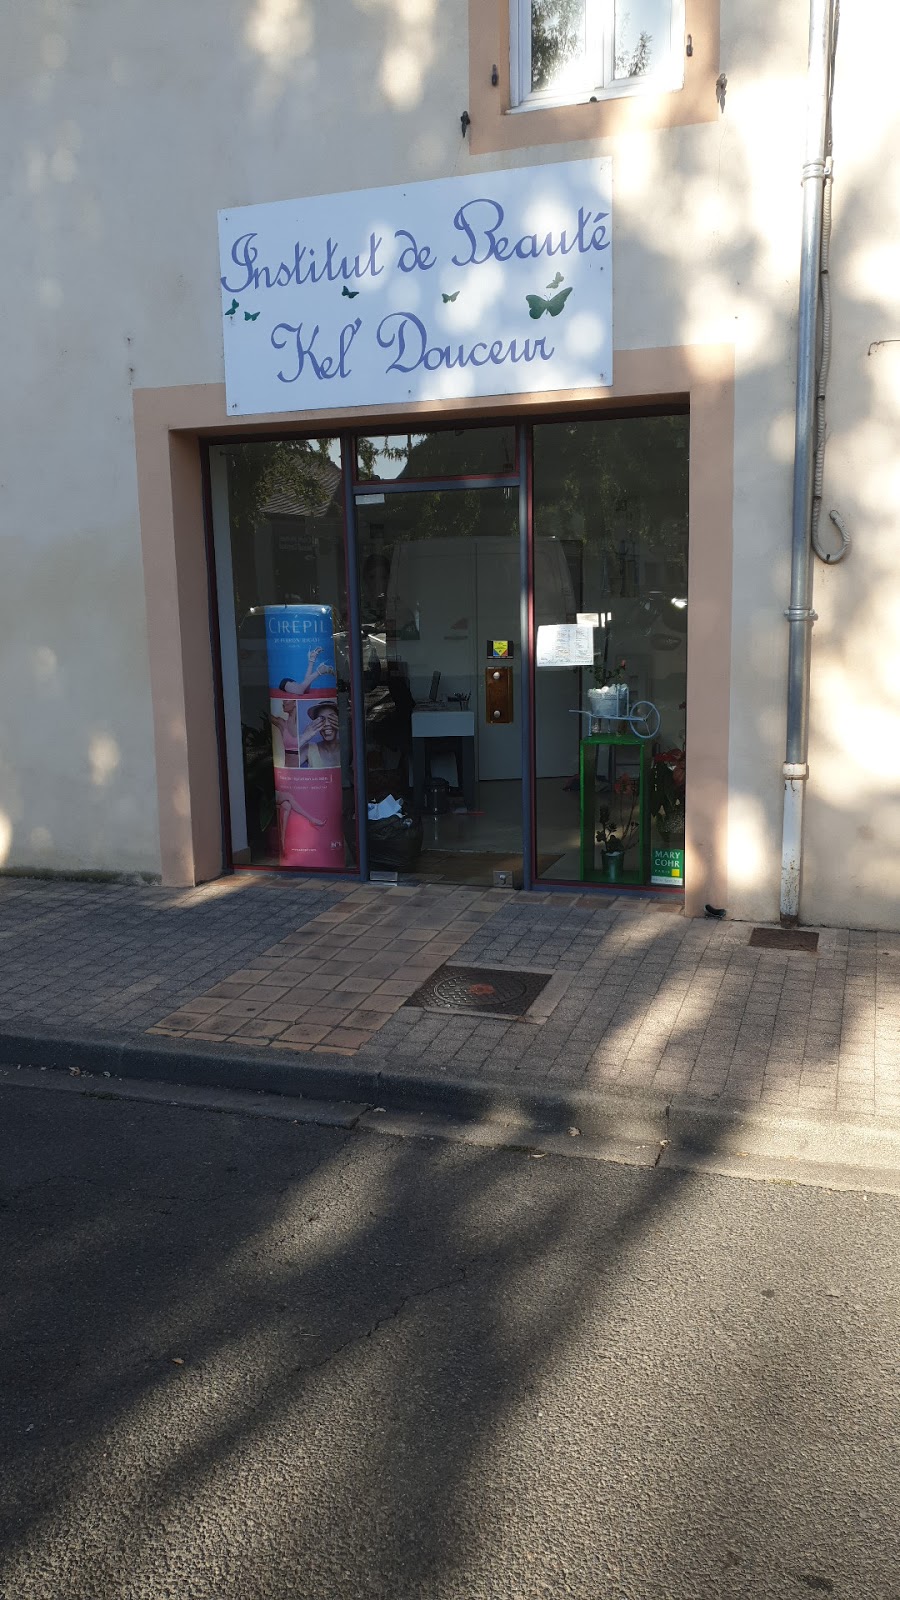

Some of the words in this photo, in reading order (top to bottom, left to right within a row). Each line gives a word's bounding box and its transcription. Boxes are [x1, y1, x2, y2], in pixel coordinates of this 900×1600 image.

[220, 232, 385, 293] Institut
[394, 229, 437, 273] de
[451, 198, 611, 267] Beauté
[270, 317, 362, 383] Kel'
[376, 311, 555, 374] Douceur
[654, 859, 680, 868] COHR
[655, 850, 681, 859] MARY
